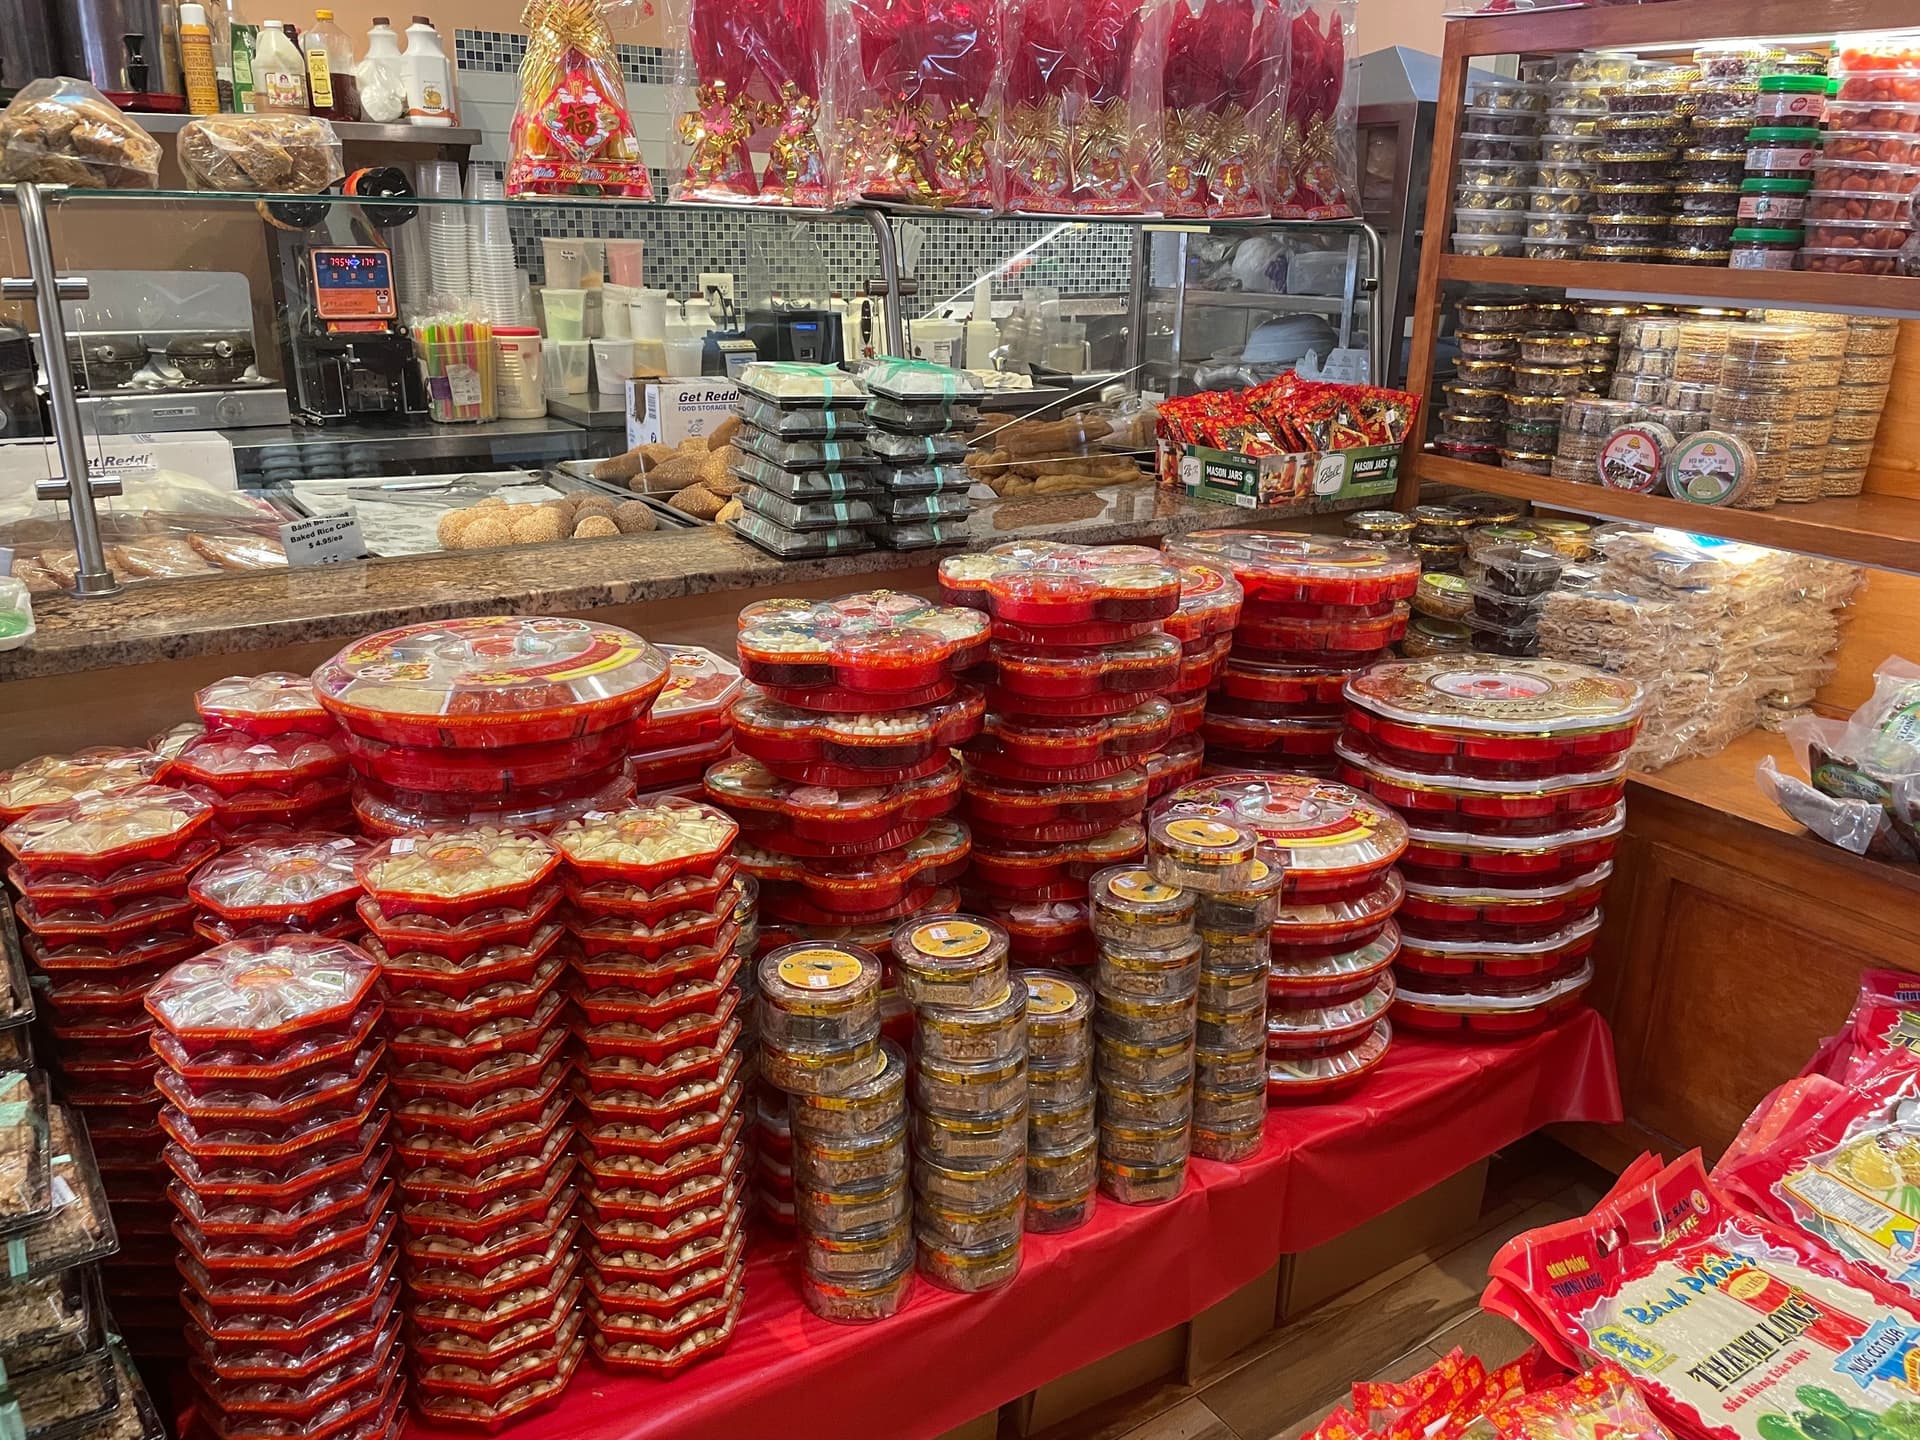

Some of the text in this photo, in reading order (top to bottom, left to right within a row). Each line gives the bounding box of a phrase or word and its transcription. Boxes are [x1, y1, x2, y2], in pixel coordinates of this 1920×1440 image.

[564, 104, 597, 136] 福
[330, 257, 375, 267] 7954 174
[678, 391, 701, 402] Get
[87, 454, 149, 467] et Reddi
[1319, 458, 1388, 484] Ball MASON JARS
[1206, 464, 1227, 479] MASON
[1227, 469, 1243, 481] JARS
[290, 520, 355, 543] Baked Rice Cake
[315, 535, 343, 547] 4.95/ea
[1621, 1287, 1693, 1327] Bánh
[1687, 1326, 1776, 1392] THANH
[1757, 1294, 1824, 1345] LONG
[1741, 1370, 1773, 1401] Riêng
